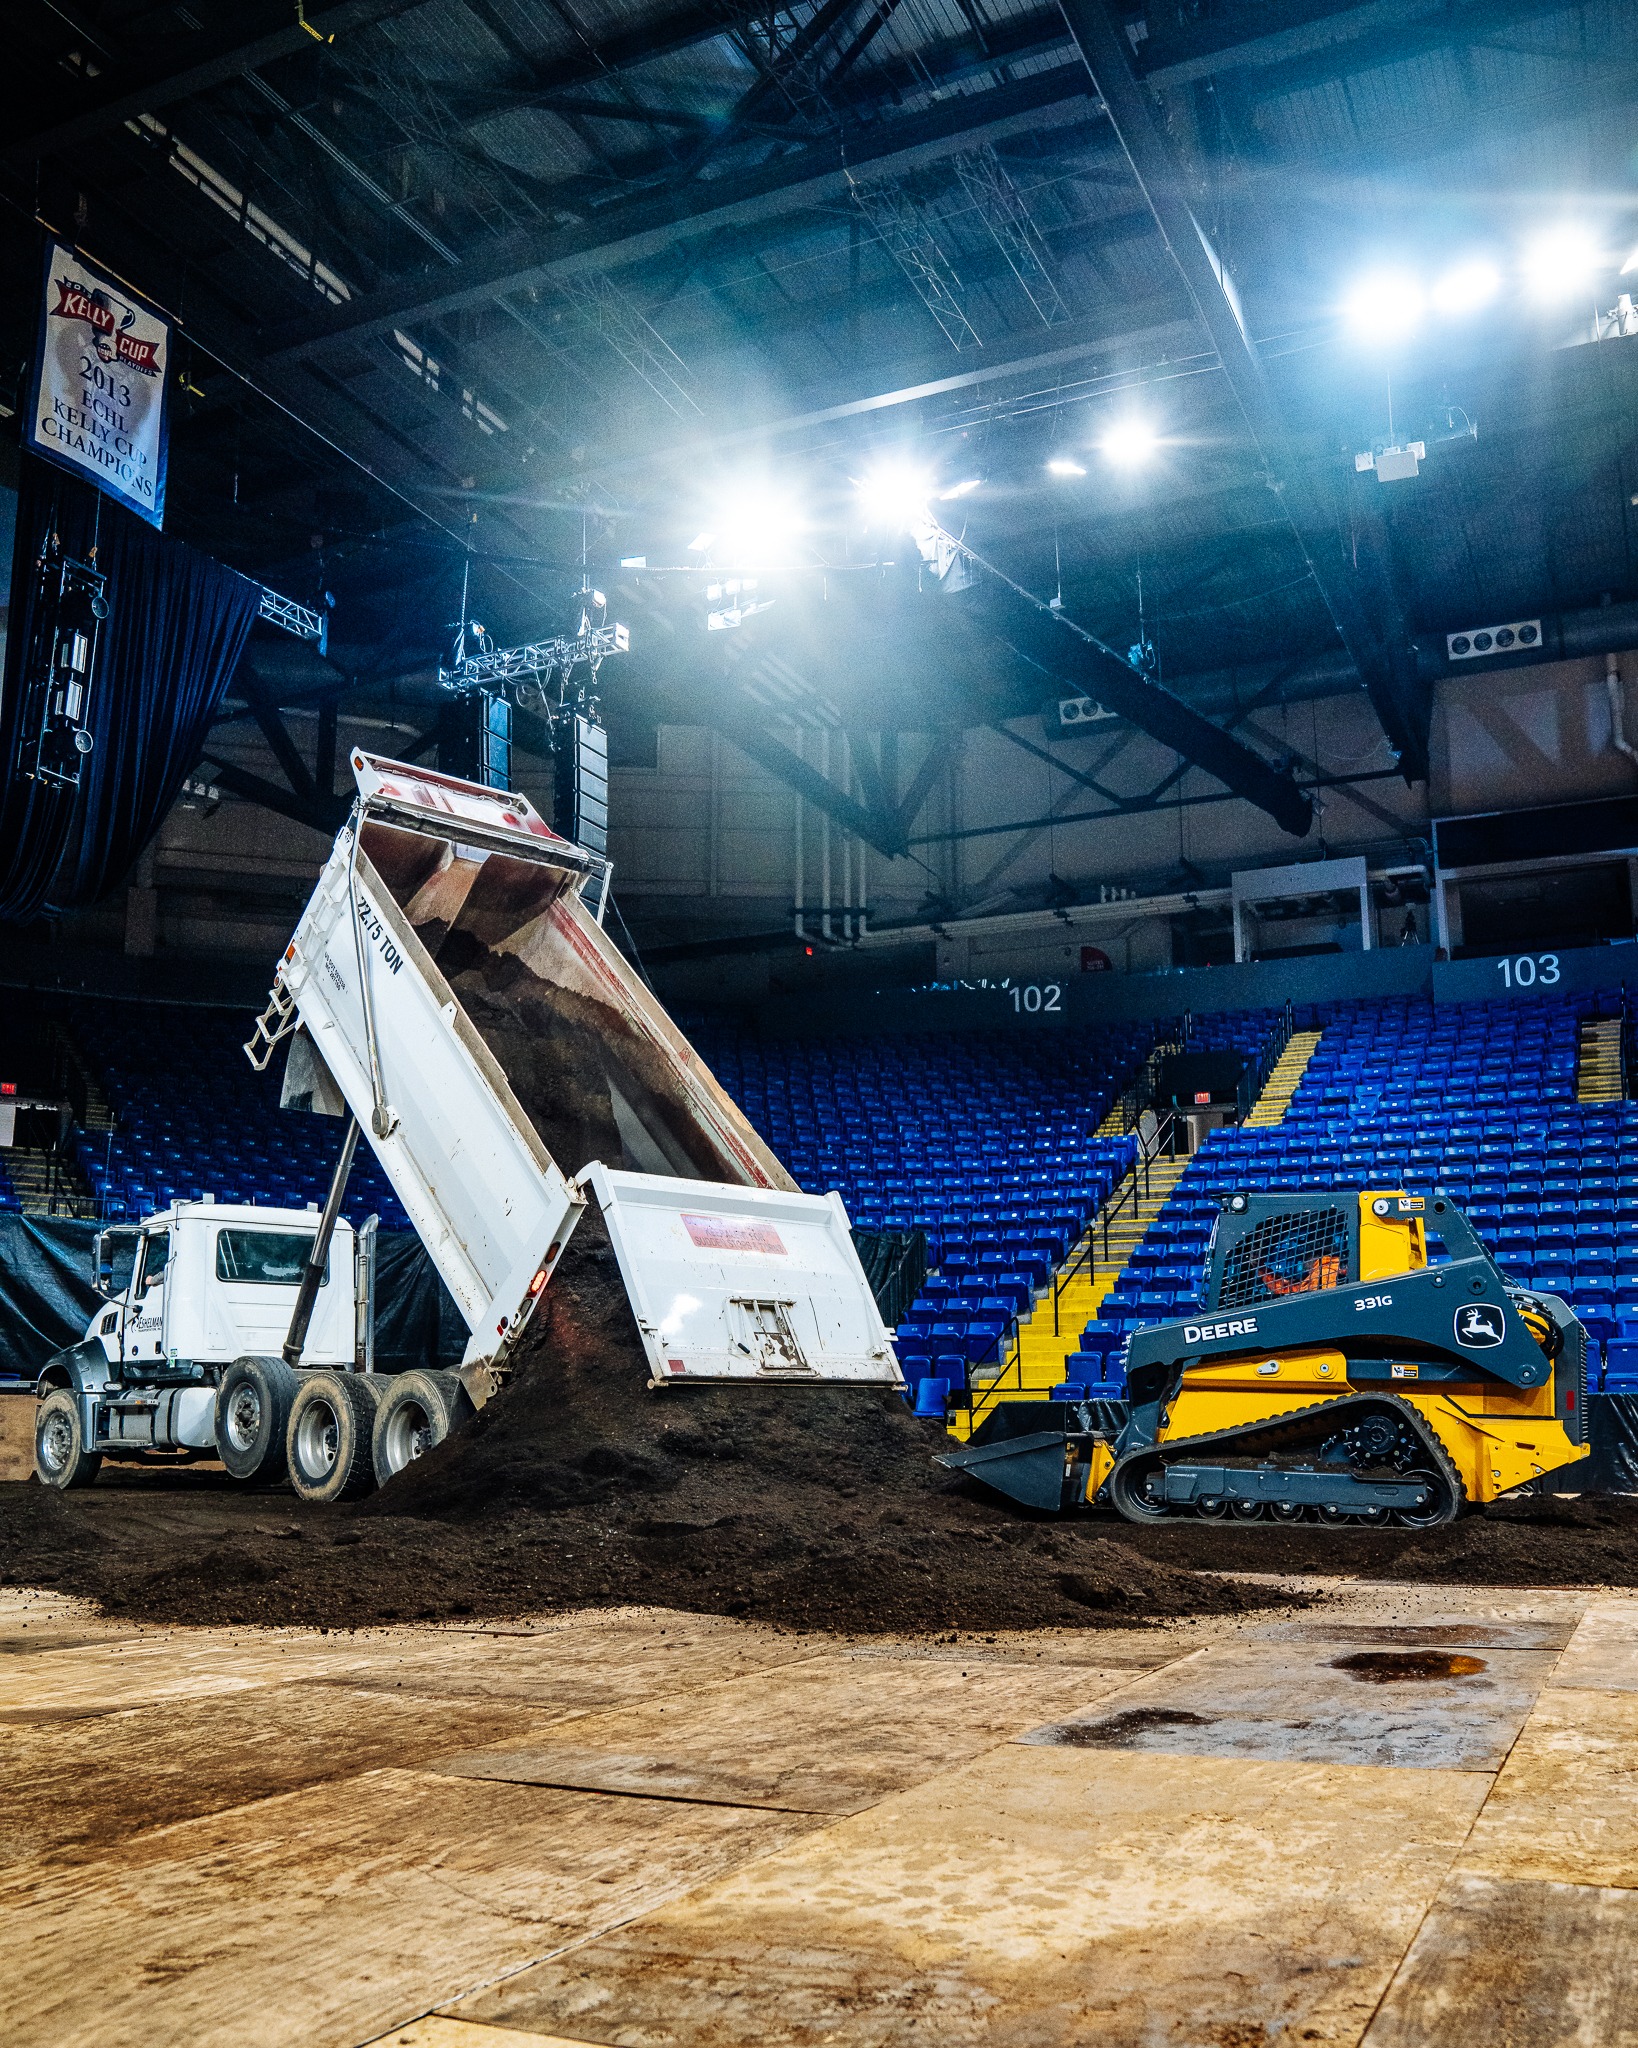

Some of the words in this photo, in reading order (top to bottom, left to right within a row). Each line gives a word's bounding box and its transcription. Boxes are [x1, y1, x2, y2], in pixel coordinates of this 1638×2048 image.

[63, 293, 111, 328] KELLY
[120, 337, 149, 361] CUP
[79, 356, 131, 407] 2013
[81, 389, 129, 434] ECHL
[53, 396, 110, 444] KELLY
[114, 437, 147, 469] CUP
[41, 417, 153, 497] CHAMPIONS
[357, 896, 384, 941] 22.75
[380, 935, 404, 975] TON
[1497, 954, 1561, 988] 103
[1008, 984, 1062, 1013] 102
[1354, 1295, 1393, 1311] 331G
[1184, 1317, 1258, 1344] DEERE
